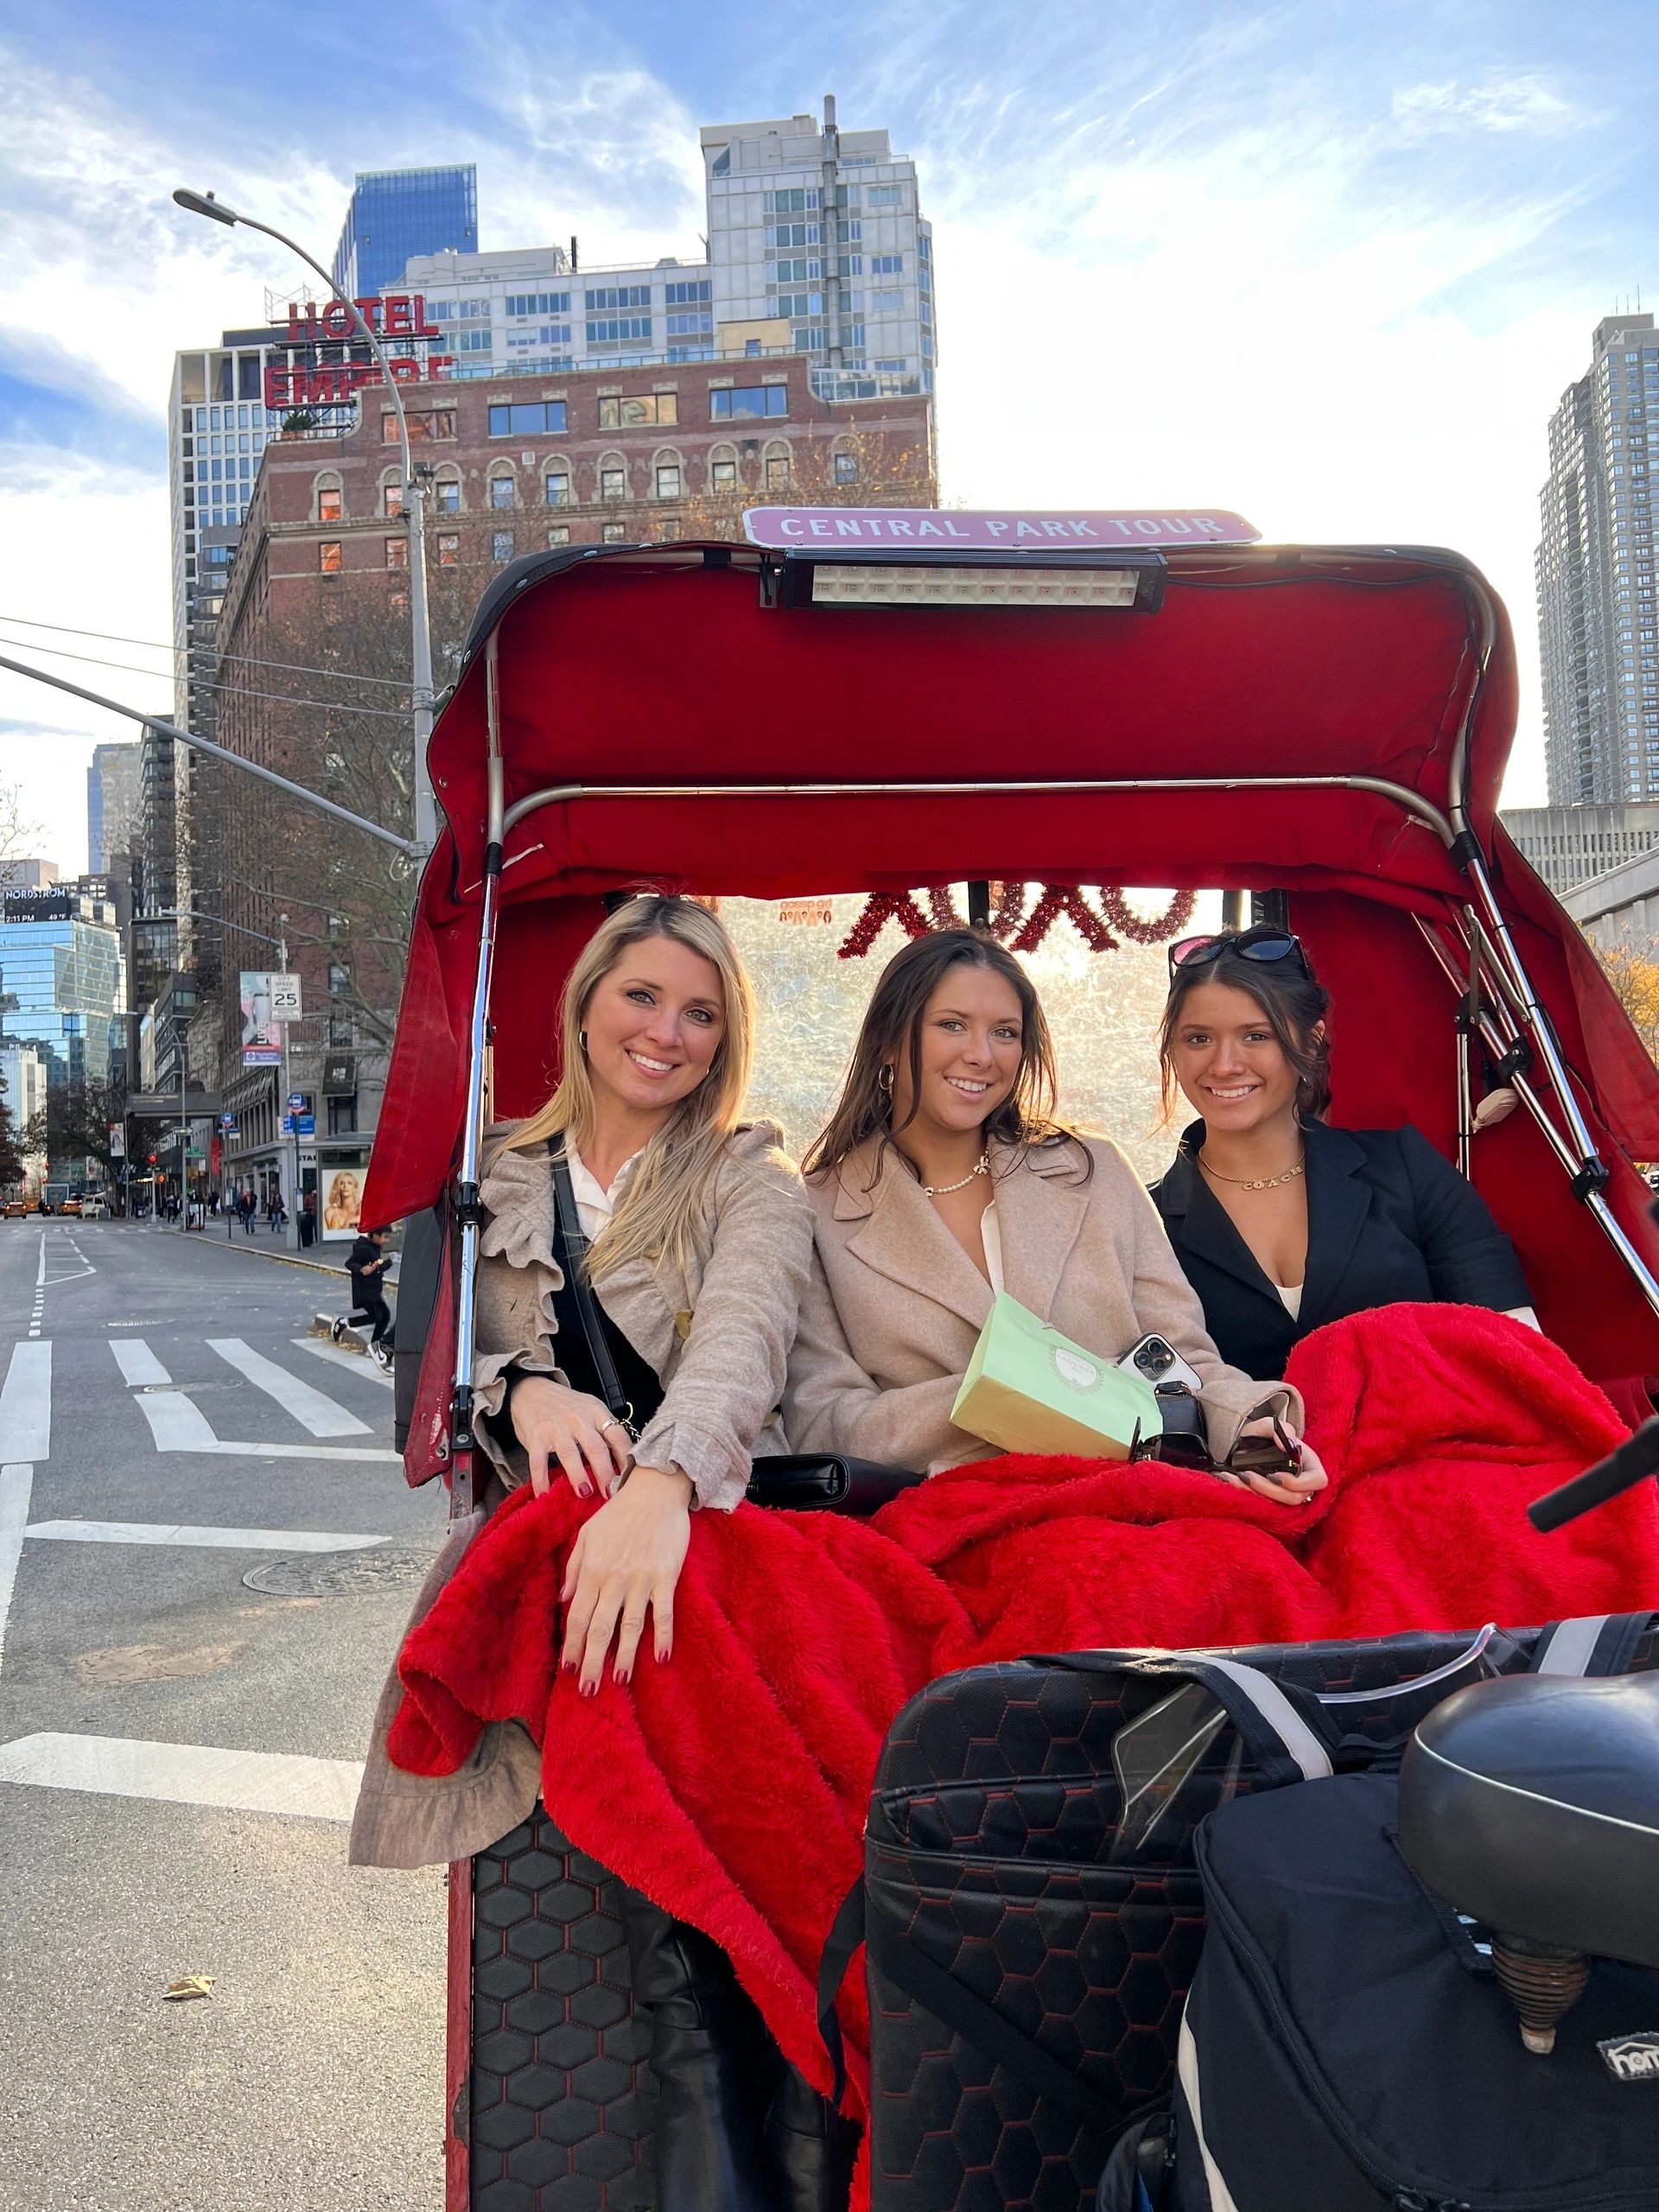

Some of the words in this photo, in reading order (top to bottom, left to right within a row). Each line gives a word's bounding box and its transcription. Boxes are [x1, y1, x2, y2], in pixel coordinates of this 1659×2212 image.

[289, 295, 439, 340] HOTEL
[264, 356, 453, 408] EMPRE
[779, 518, 970, 537] CENTRAL
[985, 519, 1099, 537] PARK
[1108, 517, 1225, 536] TOUR
[5, 887, 66, 899] NORDSTROM
[780, 900, 815, 912] gossip
[817, 898, 832, 910] girl
[22, 914, 35, 923] PM
[275, 994, 296, 1006] 25
